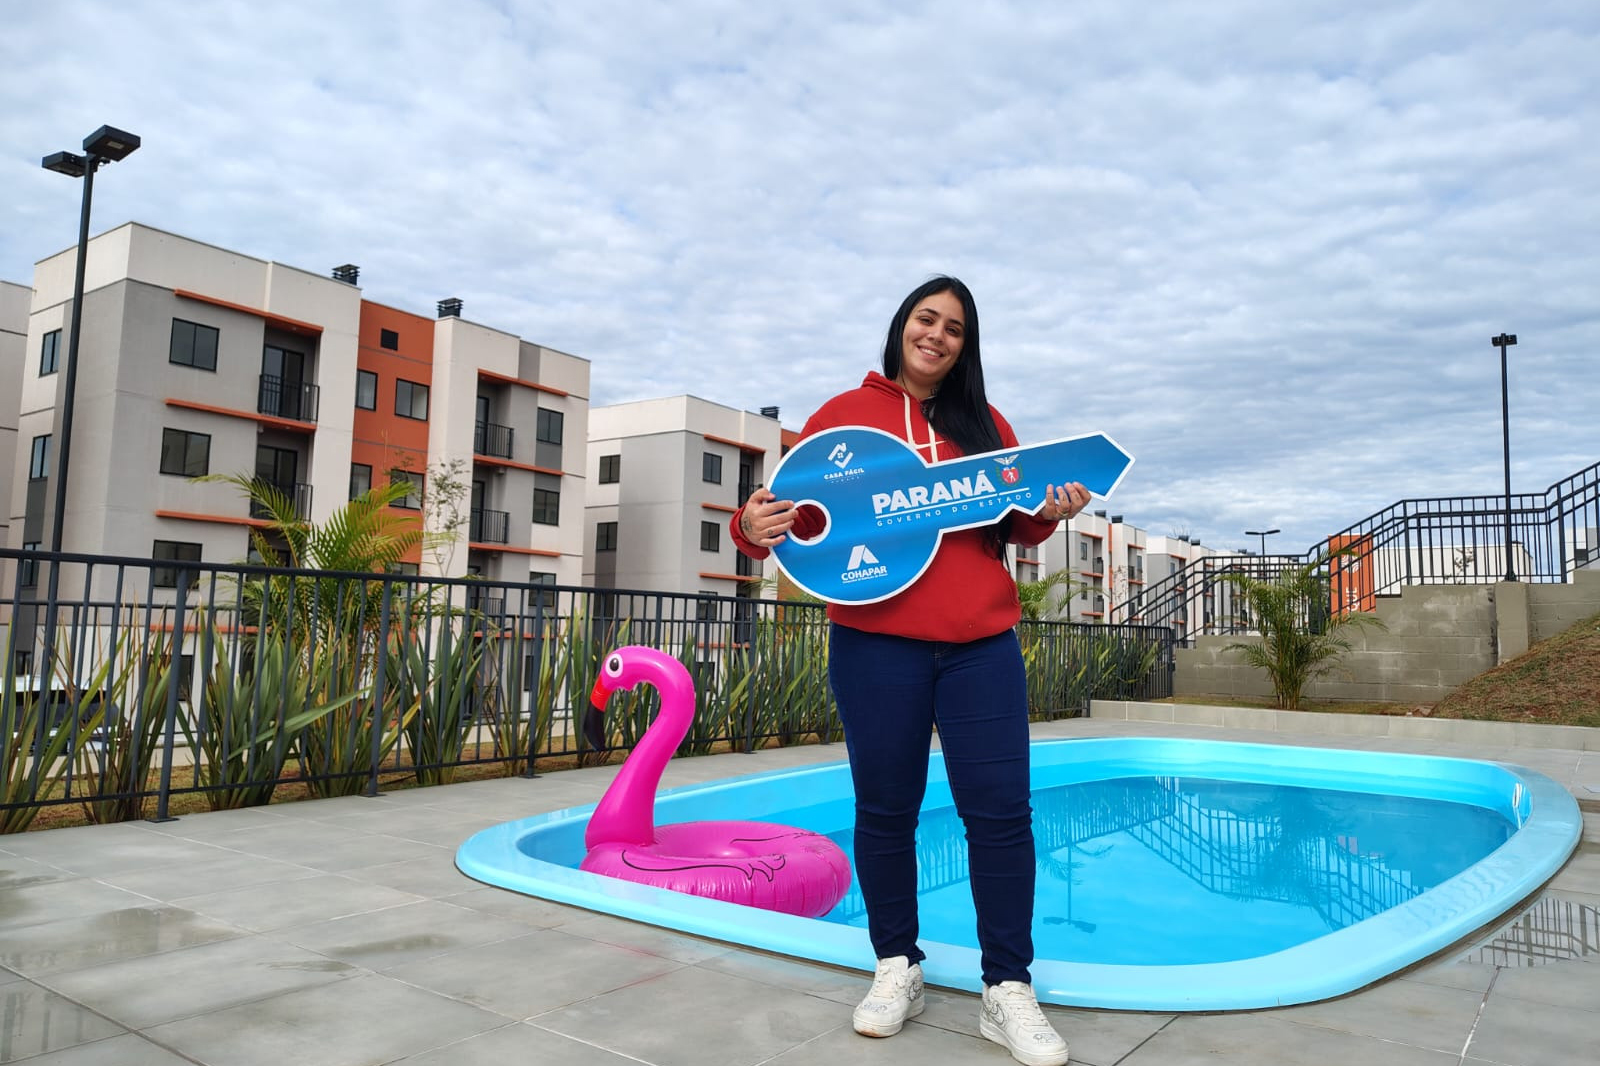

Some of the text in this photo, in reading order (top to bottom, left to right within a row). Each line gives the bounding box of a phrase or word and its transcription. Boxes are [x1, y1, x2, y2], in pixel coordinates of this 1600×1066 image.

[872, 469, 996, 515] PARANÁ
[876, 492, 1033, 527] GOVERNO DO ESTADO
[841, 565, 888, 581] COHAPAR
